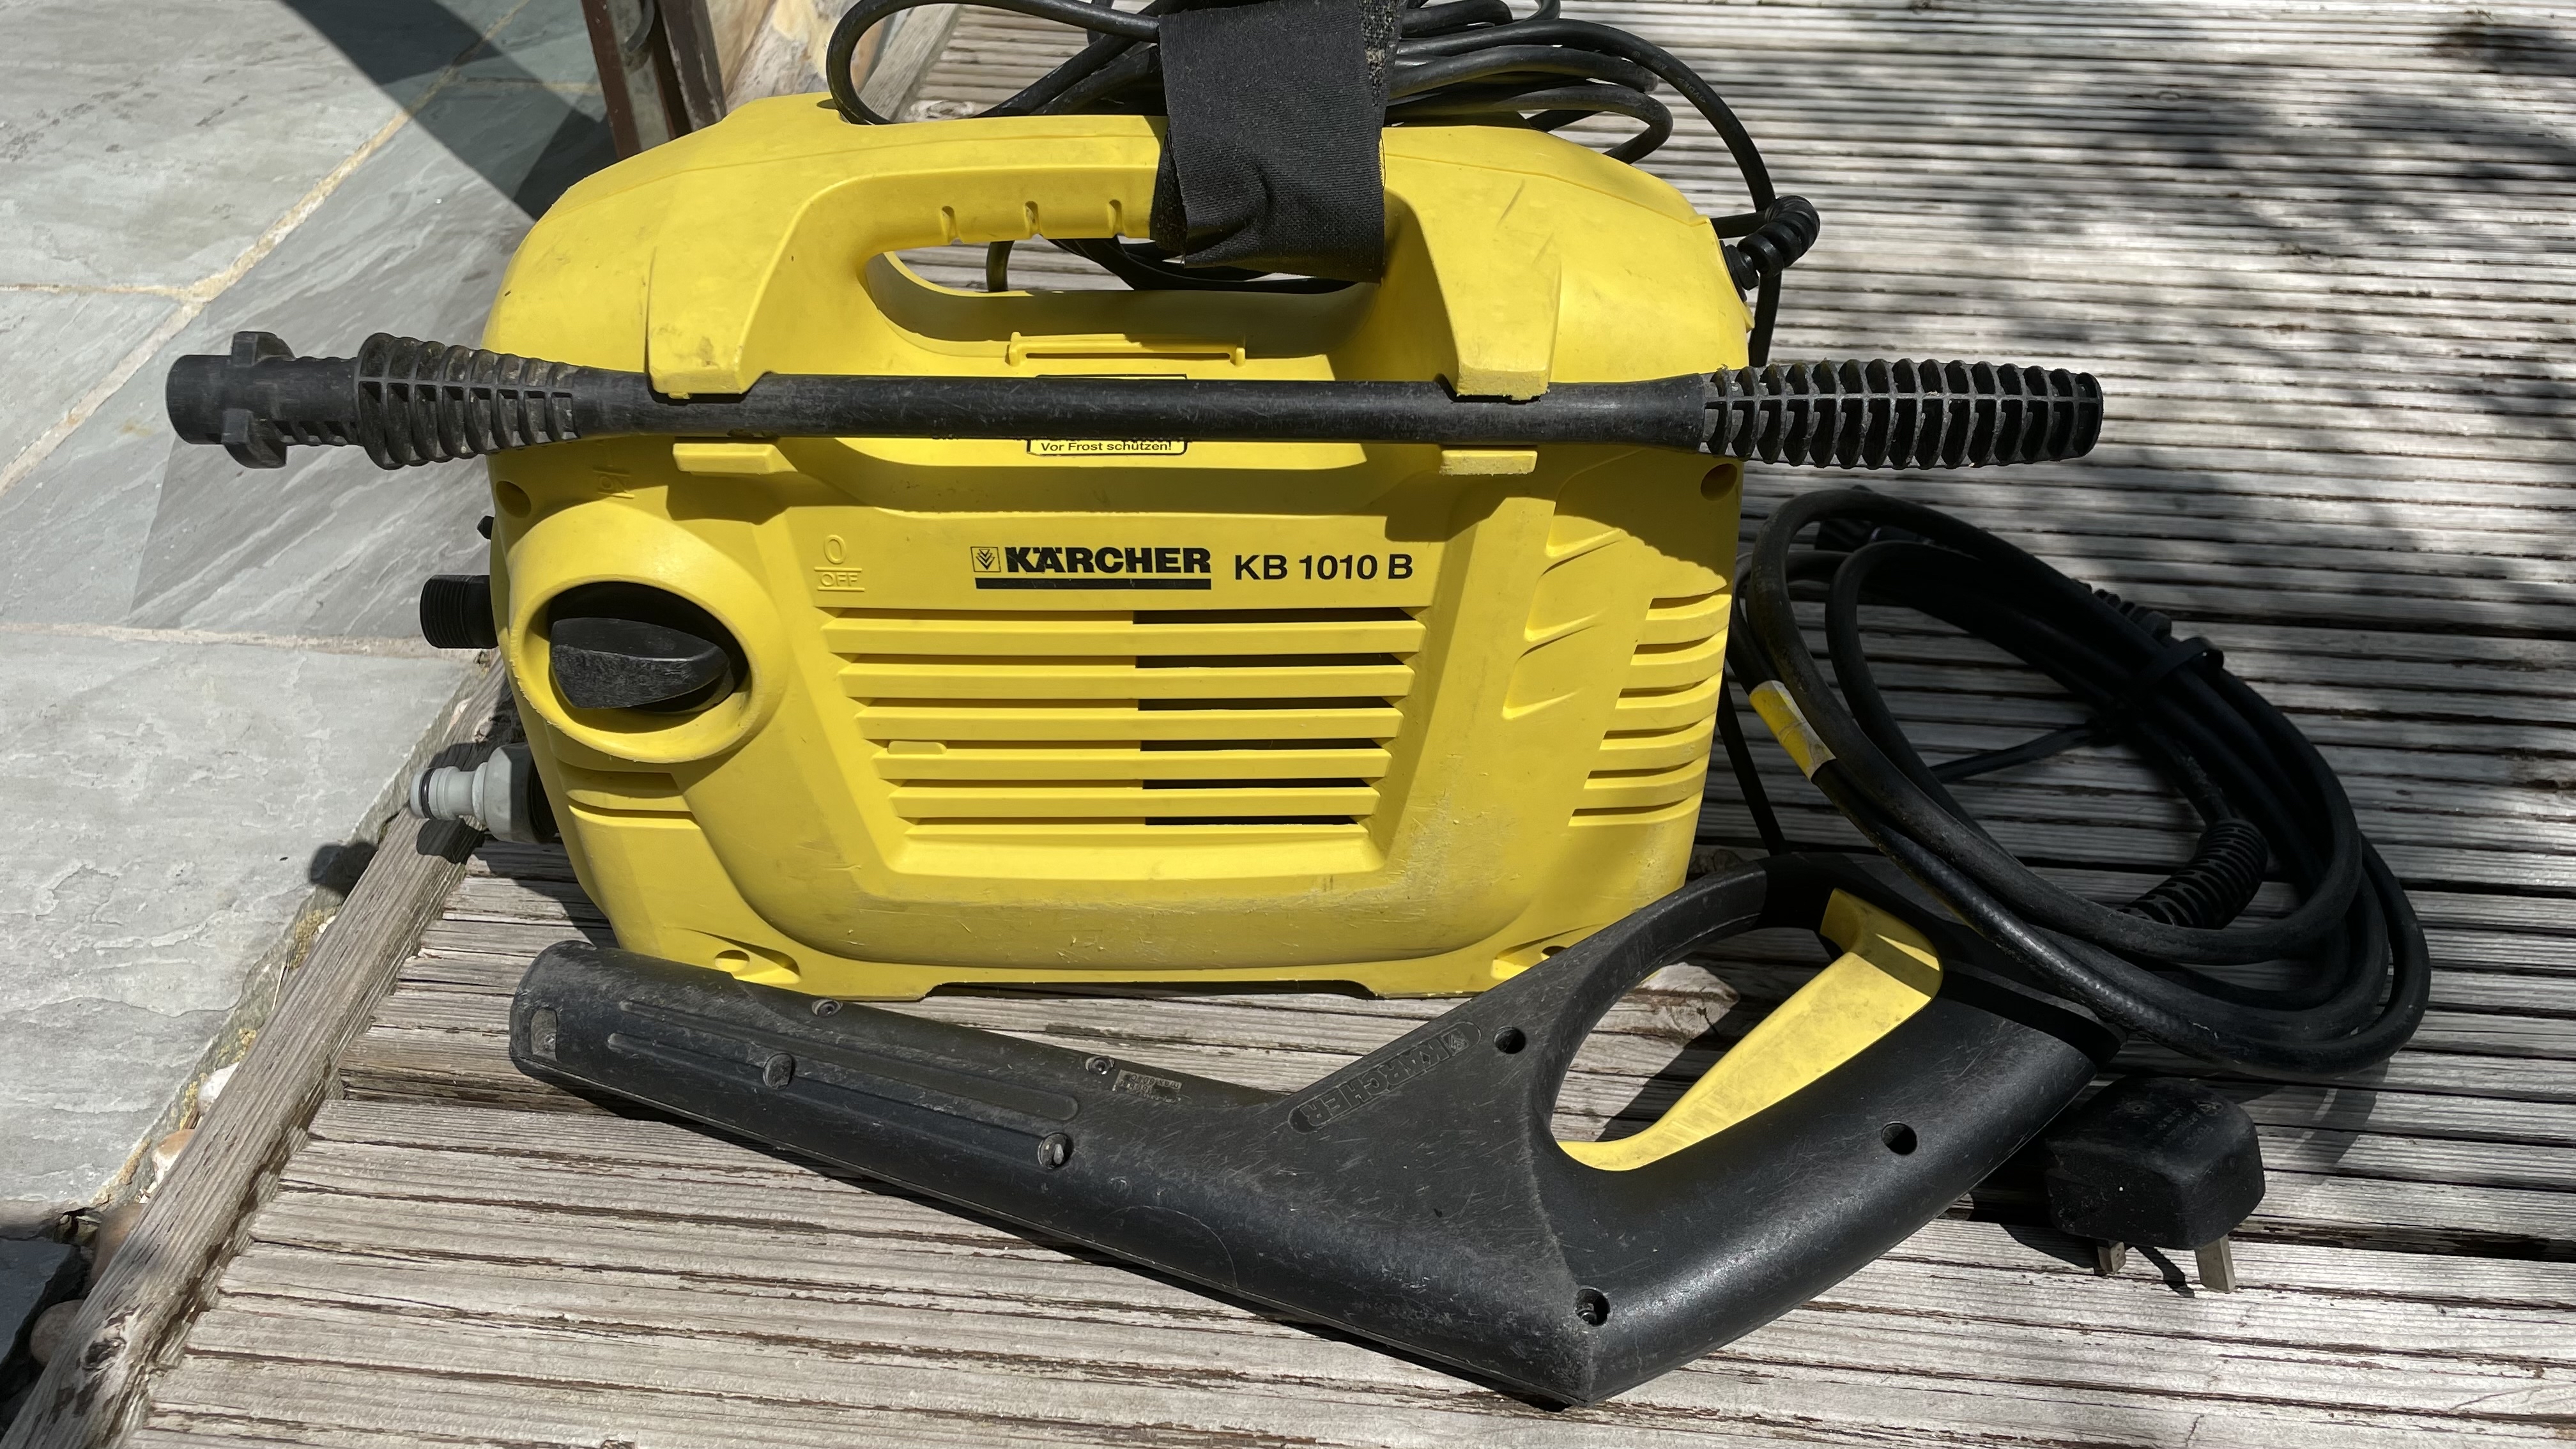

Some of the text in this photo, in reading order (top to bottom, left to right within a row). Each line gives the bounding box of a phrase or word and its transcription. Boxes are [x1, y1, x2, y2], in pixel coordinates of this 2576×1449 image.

[1041, 440, 1172, 450] Vor Frost schützen!
[1004, 546, 1413, 580] KÄRCHER KB 1010 B
[820, 572, 858, 587] OFF
